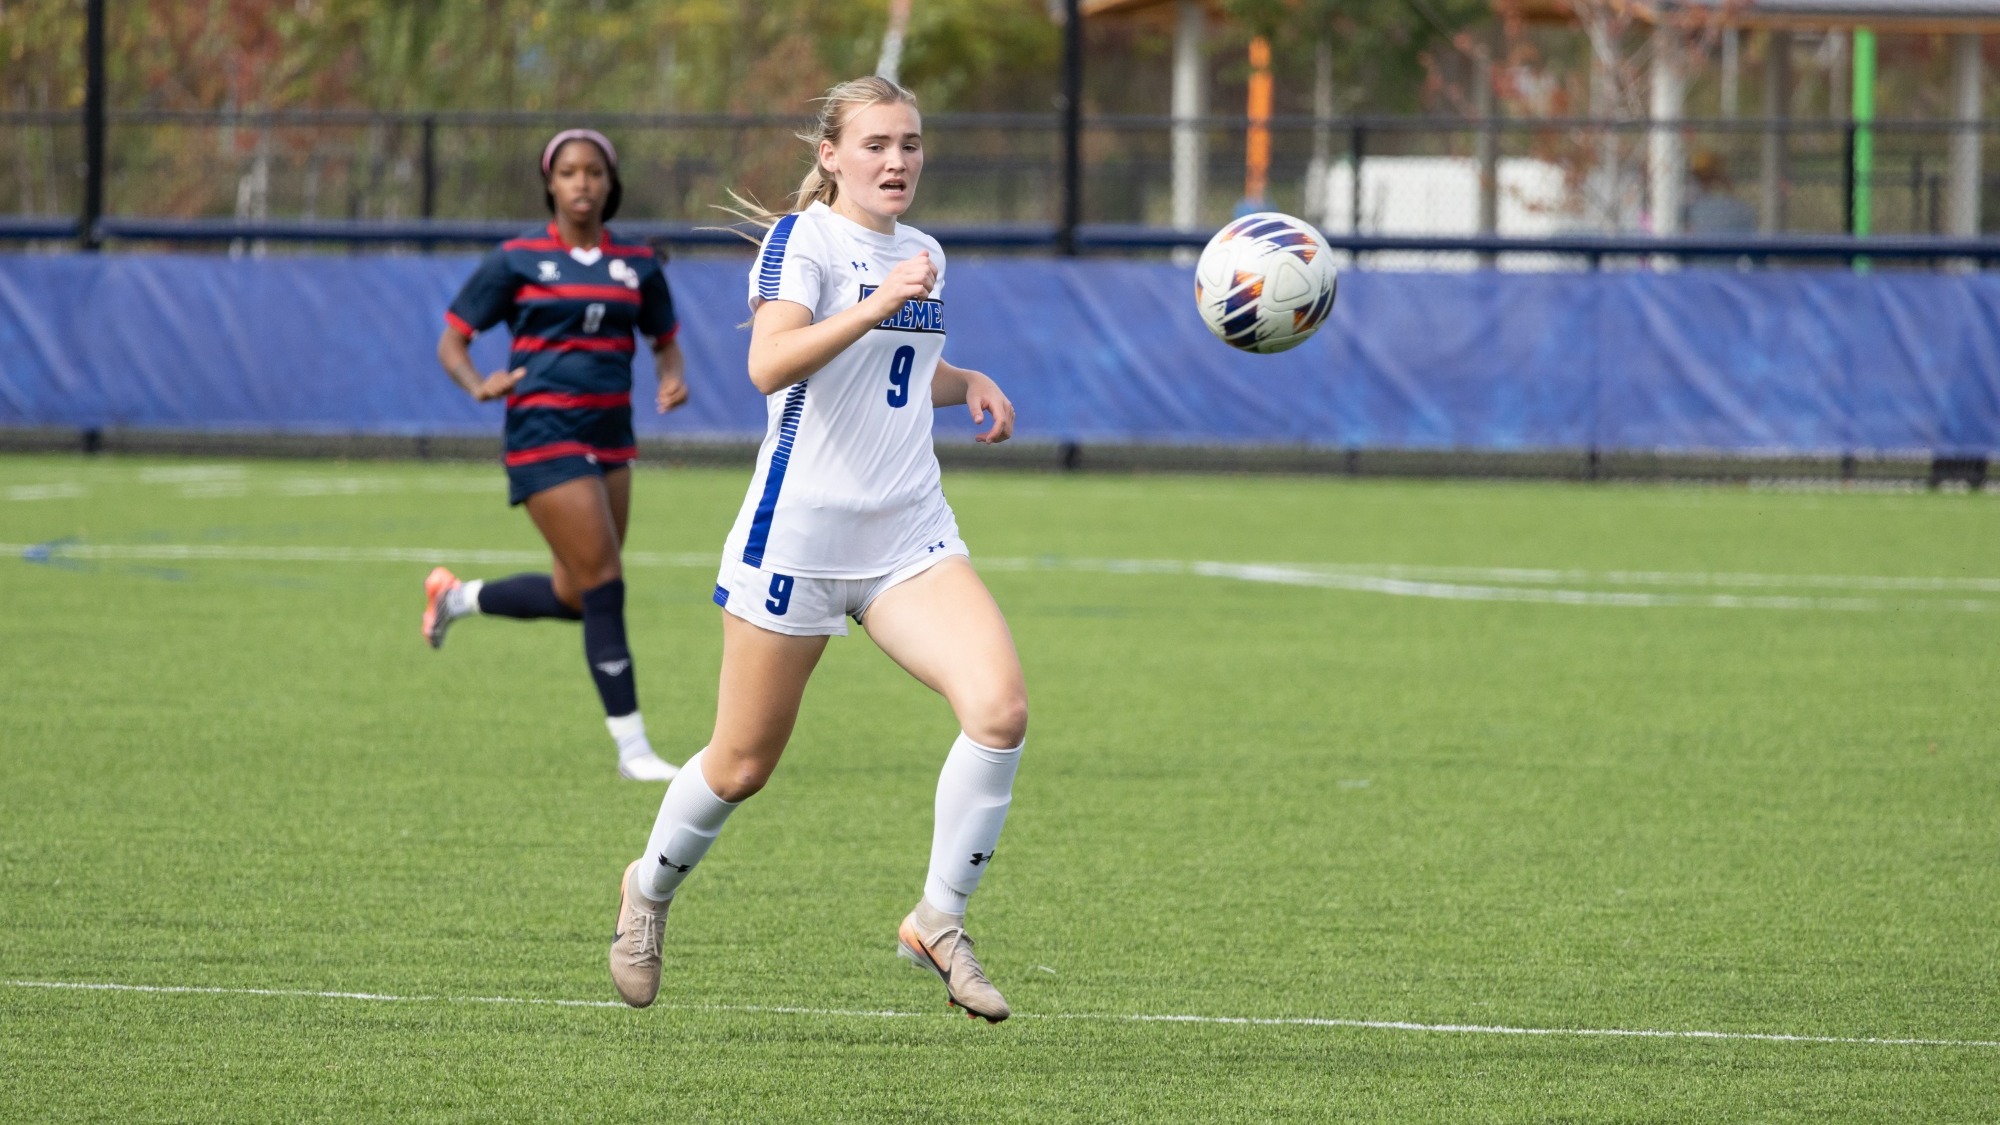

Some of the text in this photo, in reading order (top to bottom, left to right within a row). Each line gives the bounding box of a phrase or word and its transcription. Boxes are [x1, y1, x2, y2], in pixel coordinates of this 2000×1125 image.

[862, 287, 944, 331] AEME
[886, 345, 915, 408] 9
[765, 573, 794, 616] 9
